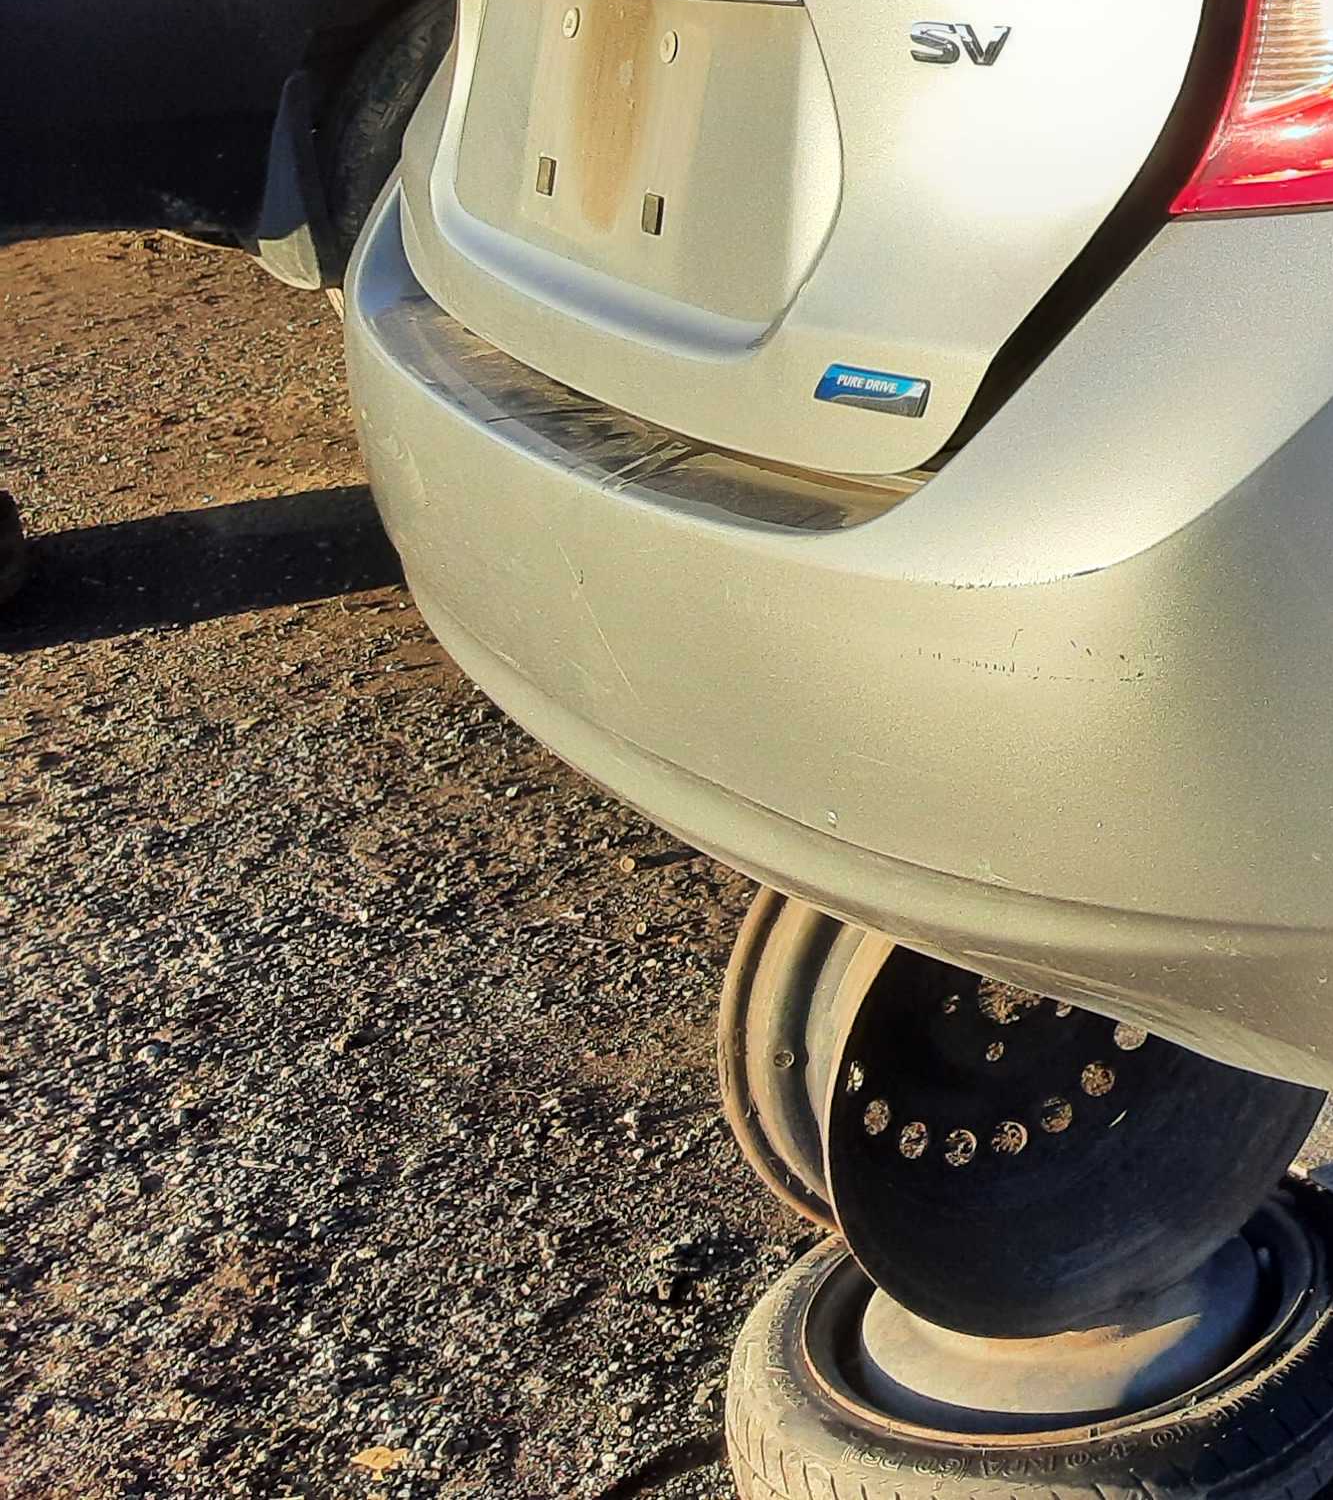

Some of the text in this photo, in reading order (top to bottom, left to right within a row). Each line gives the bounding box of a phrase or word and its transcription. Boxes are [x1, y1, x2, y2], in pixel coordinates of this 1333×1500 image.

[909, 20, 1013, 67] SV
[836, 373, 898, 394] PURE DRIVE
